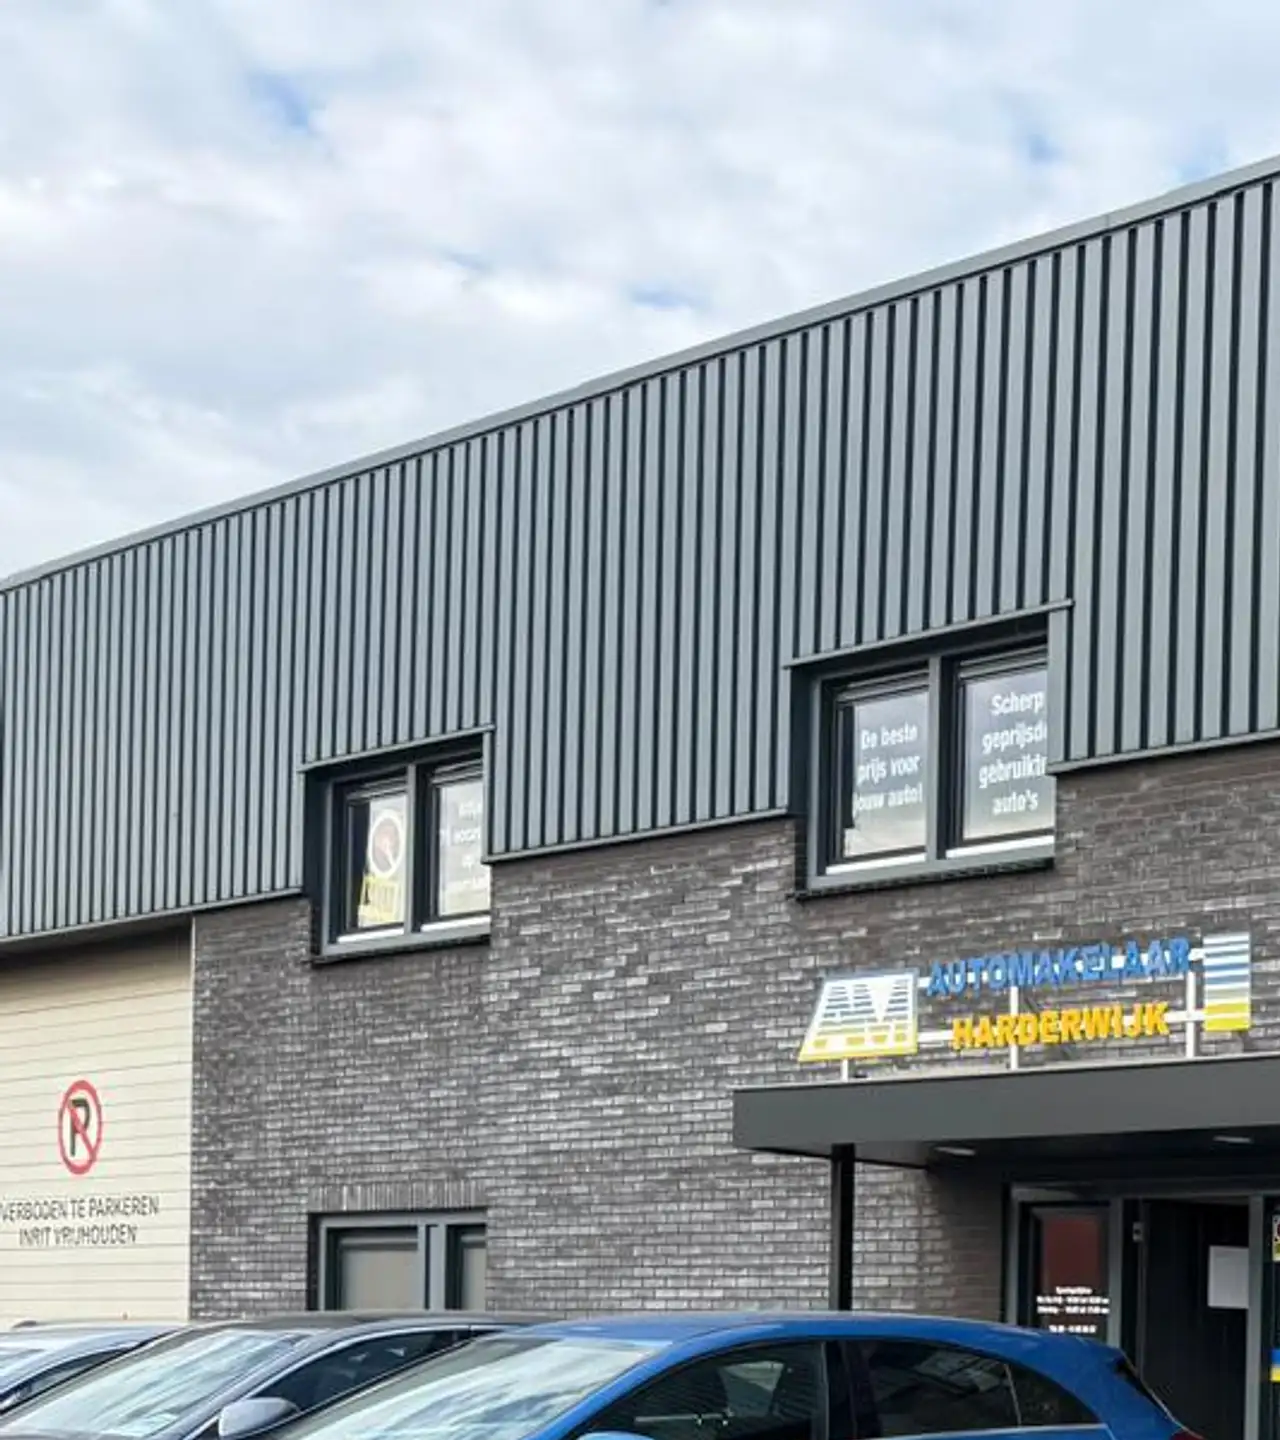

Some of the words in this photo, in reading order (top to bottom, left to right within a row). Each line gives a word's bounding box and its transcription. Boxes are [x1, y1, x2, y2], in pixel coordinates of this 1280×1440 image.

[991, 690, 1044, 716] Scherp
[861, 729, 878, 750] De
[880, 721, 918, 747] beste
[857, 757, 887, 787] prijs
[891, 755, 920, 777] voor
[993, 788, 1038, 815] auto's
[926, 937, 1190, 997] AUTOMAKELAAR
[952, 1002, 1169, 1050] HARDERWIJK
[0, 1200, 67, 1222] VERBODEN
[70, 1199, 86, 1219] TE
[89, 1194, 160, 1218] PARKEREN
[19, 1226, 50, 1246] INRIT
